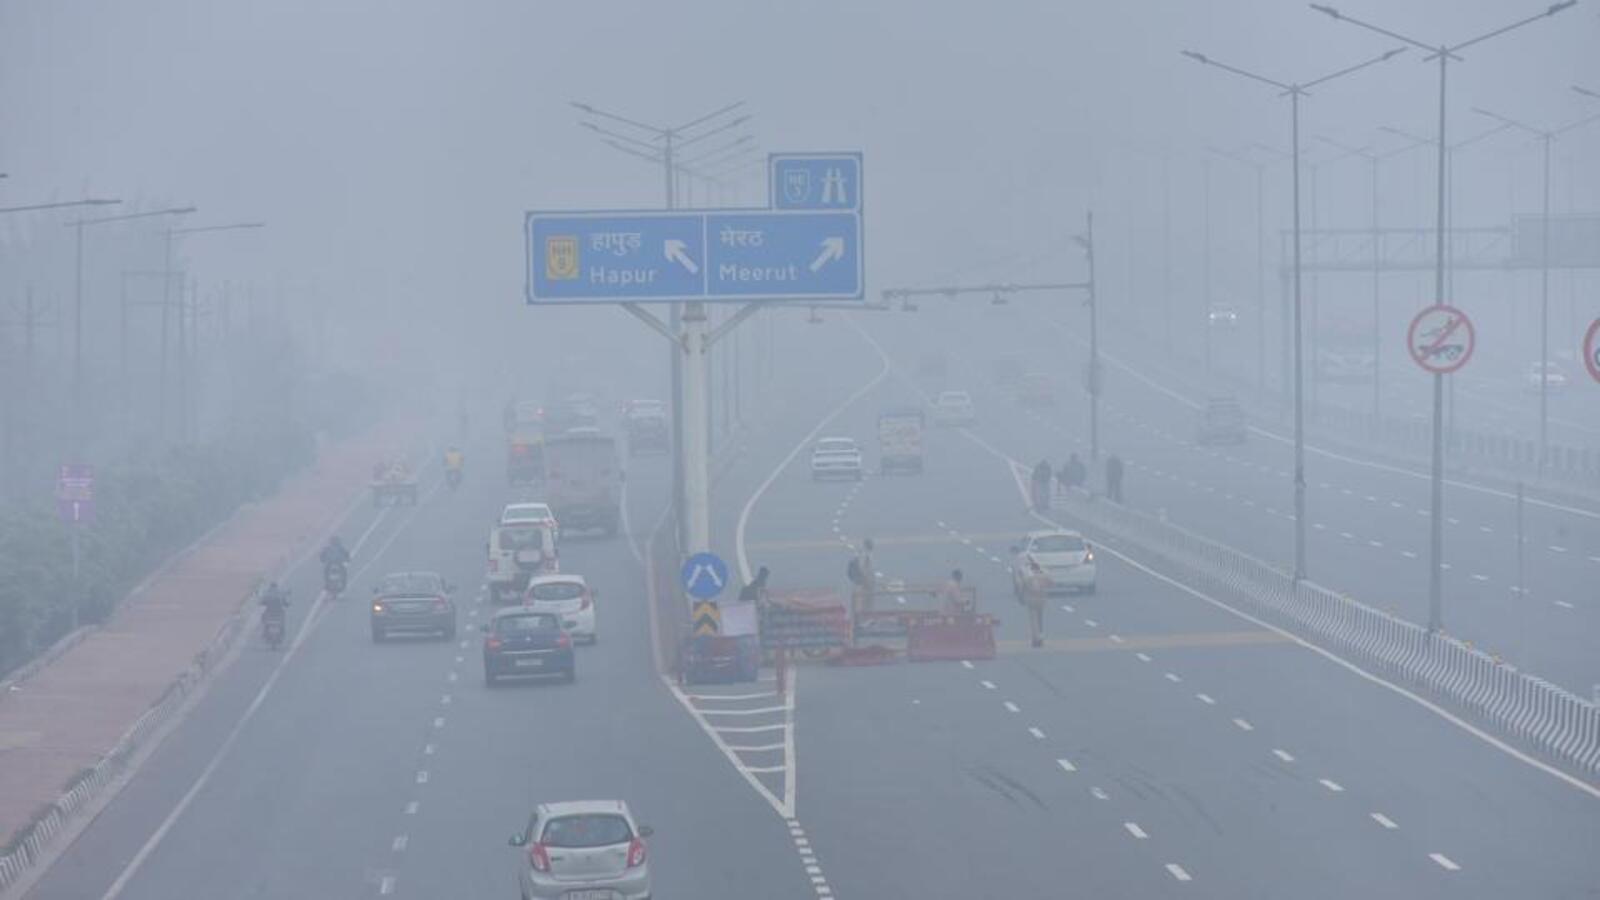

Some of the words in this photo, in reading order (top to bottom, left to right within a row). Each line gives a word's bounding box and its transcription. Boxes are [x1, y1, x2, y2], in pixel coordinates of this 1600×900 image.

[719, 225, 764, 247] मेरठ
[589, 266, 657, 286] Hapur
[719, 263, 799, 281] Meerut
